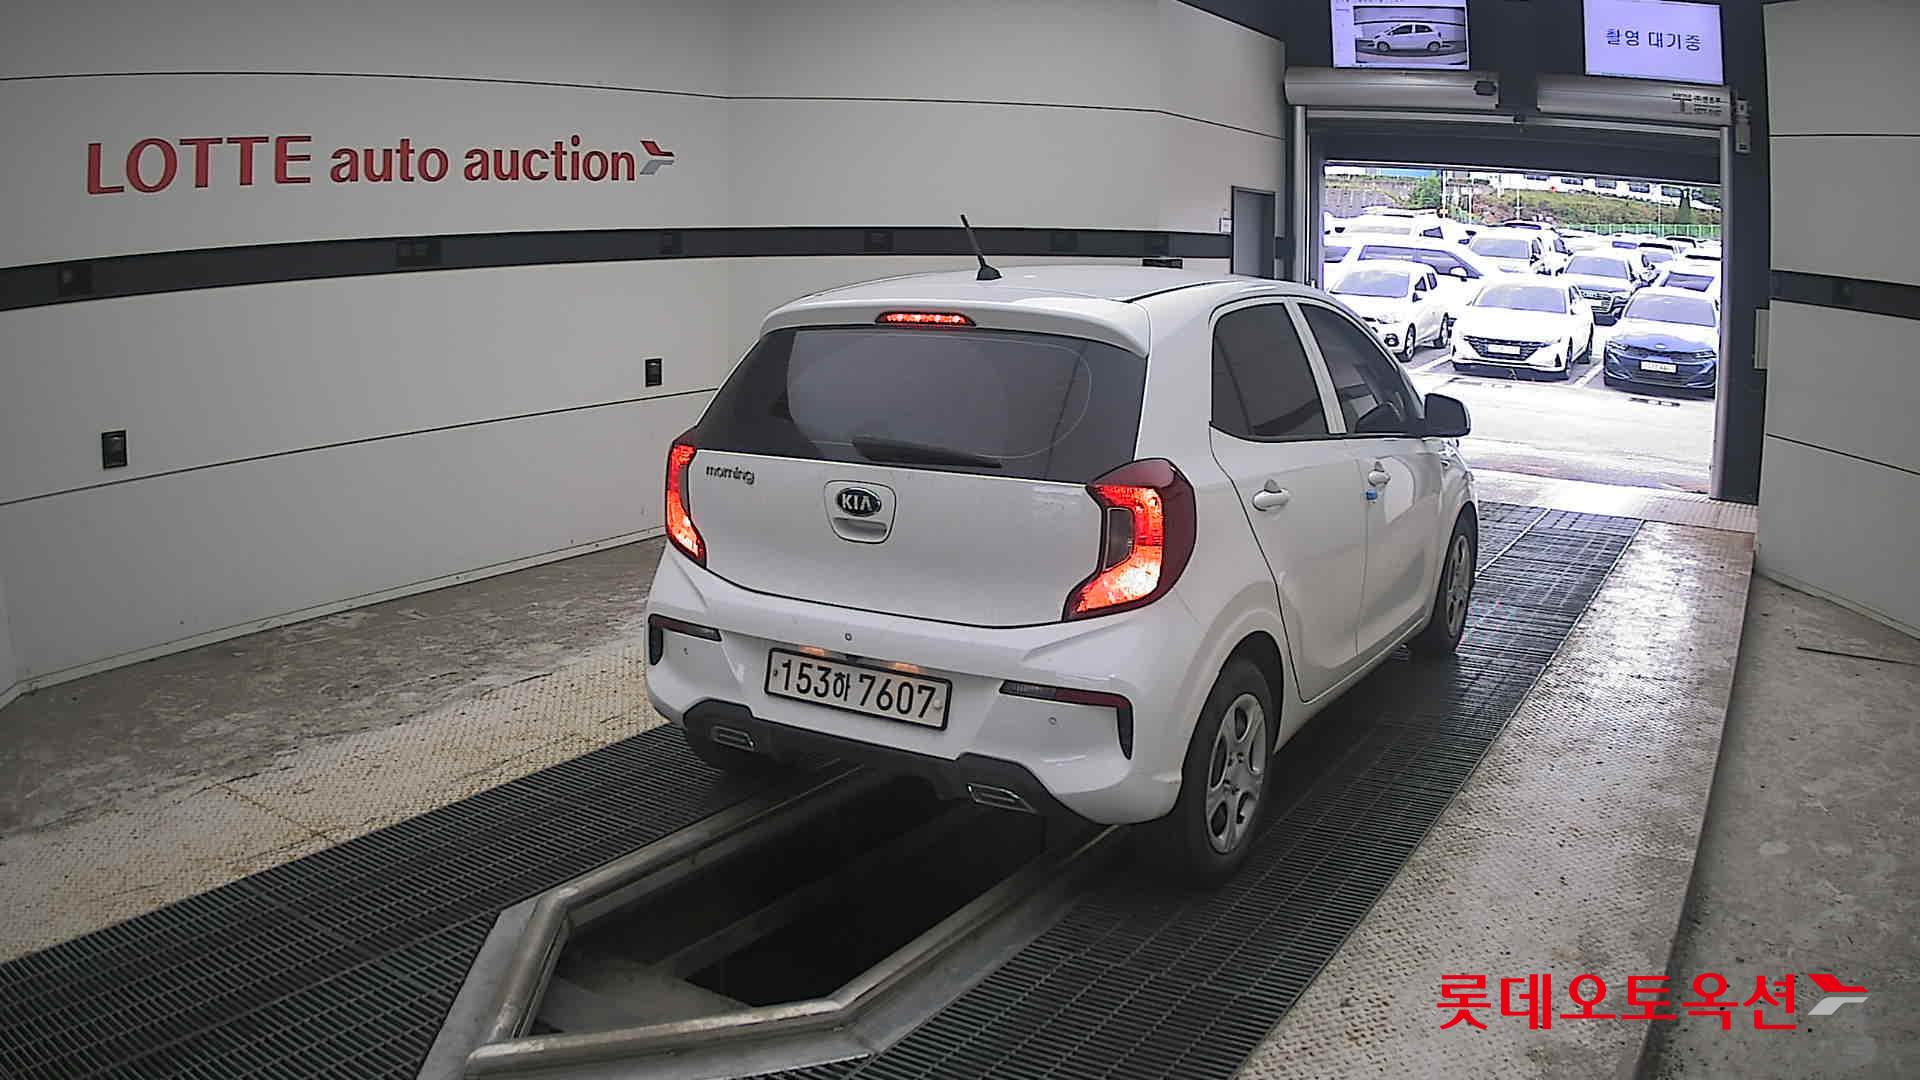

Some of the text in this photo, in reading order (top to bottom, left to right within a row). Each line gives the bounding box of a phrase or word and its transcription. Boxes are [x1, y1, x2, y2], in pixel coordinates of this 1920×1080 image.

[1648, 31, 1701, 51] 대기중
[87, 134, 636, 195] LOTTE auto auction
[706, 466, 755, 485] morning
[841, 493, 874, 512] KIA
[781, 659, 937, 719] 153하 7607
